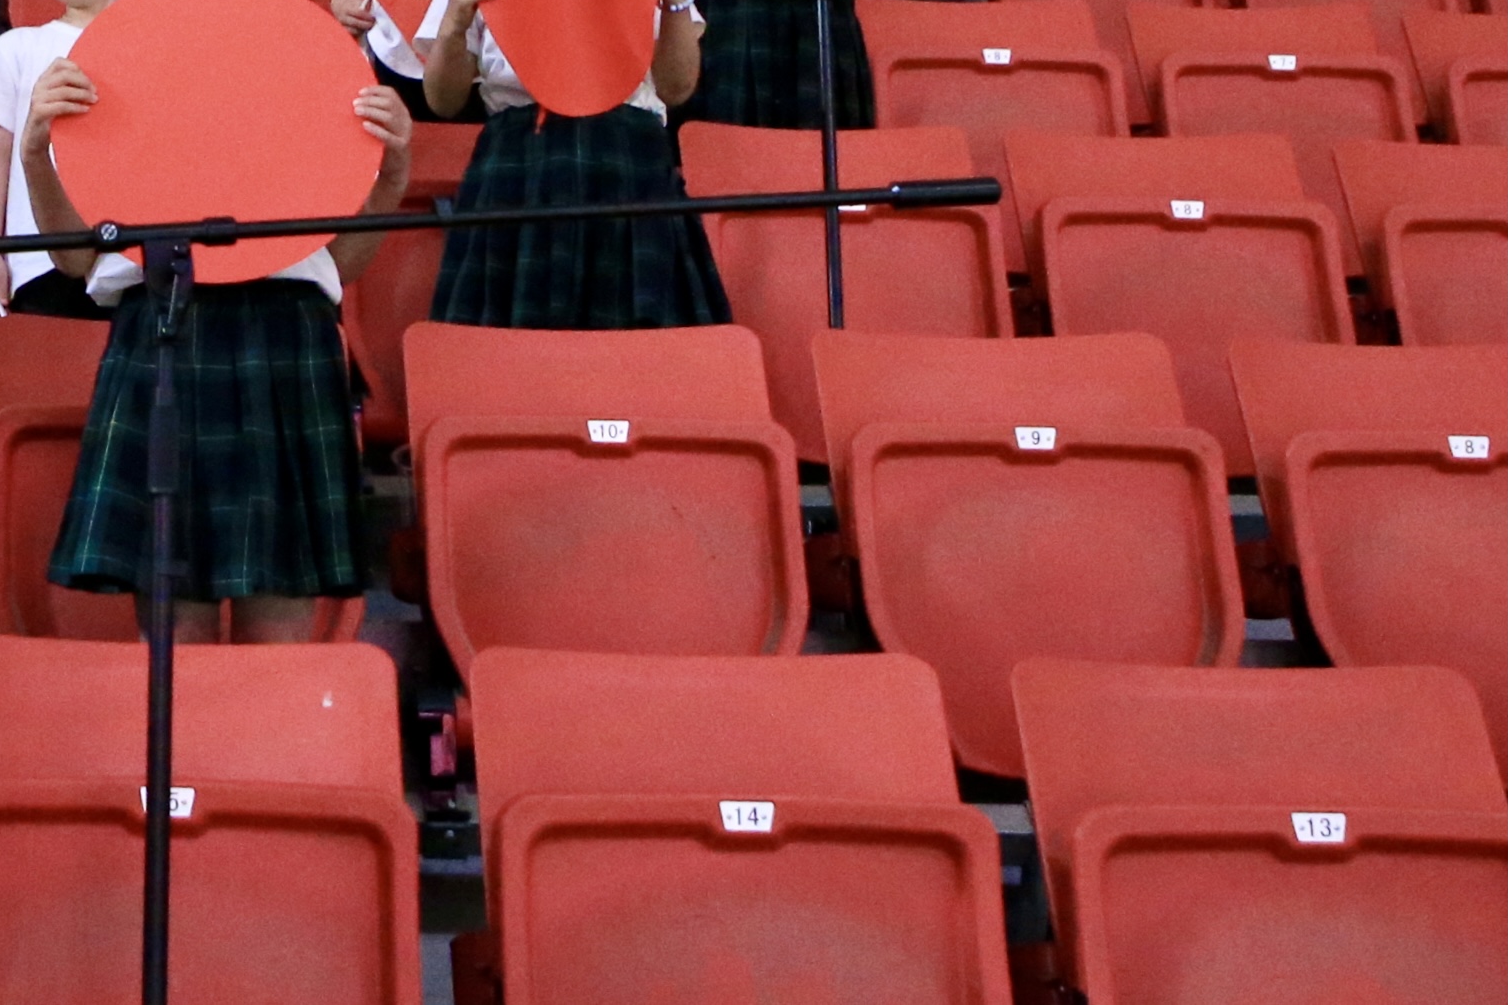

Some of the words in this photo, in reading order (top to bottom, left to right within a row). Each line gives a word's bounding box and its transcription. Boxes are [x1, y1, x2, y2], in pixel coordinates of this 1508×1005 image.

[599, 424, 618, 439] 10
[1031, 430, 1040, 446] 9
[1465, 439, 1474, 454] 8
[736, 806, 759, 826] 14
[1307, 817, 1332, 837] 13
